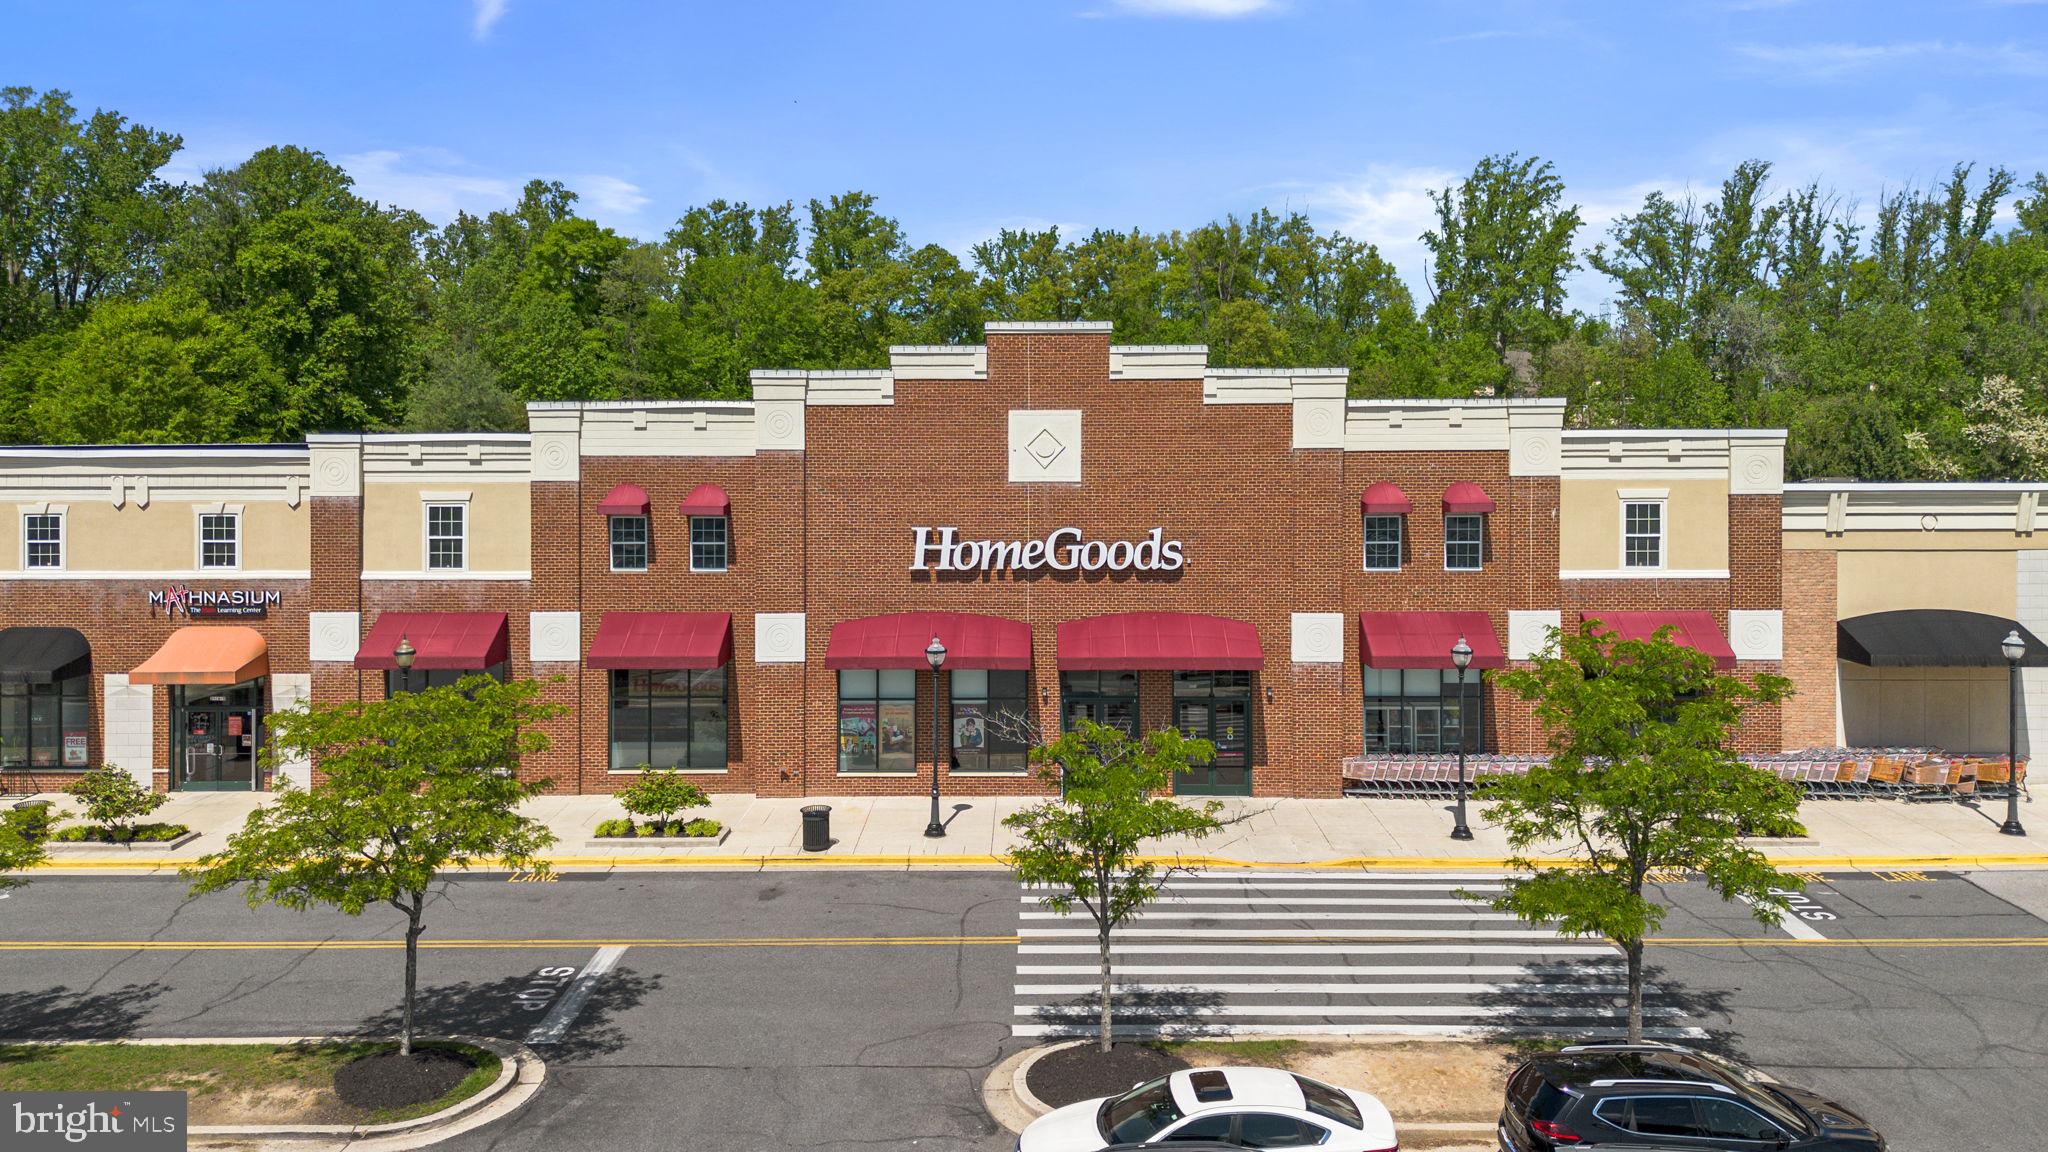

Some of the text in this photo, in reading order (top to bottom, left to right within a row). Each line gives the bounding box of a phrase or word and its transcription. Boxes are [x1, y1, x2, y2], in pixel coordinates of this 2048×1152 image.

[908, 526, 1184, 571] HomeGoods
[149, 585, 281, 615] MATHNASIUM
[217, 607, 242, 615] Learning
[508, 871, 566, 882] LANE
[1871, 871, 1938, 882] LANE
[1767, 887, 1837, 920] STOP
[512, 966, 575, 1011] STOP
